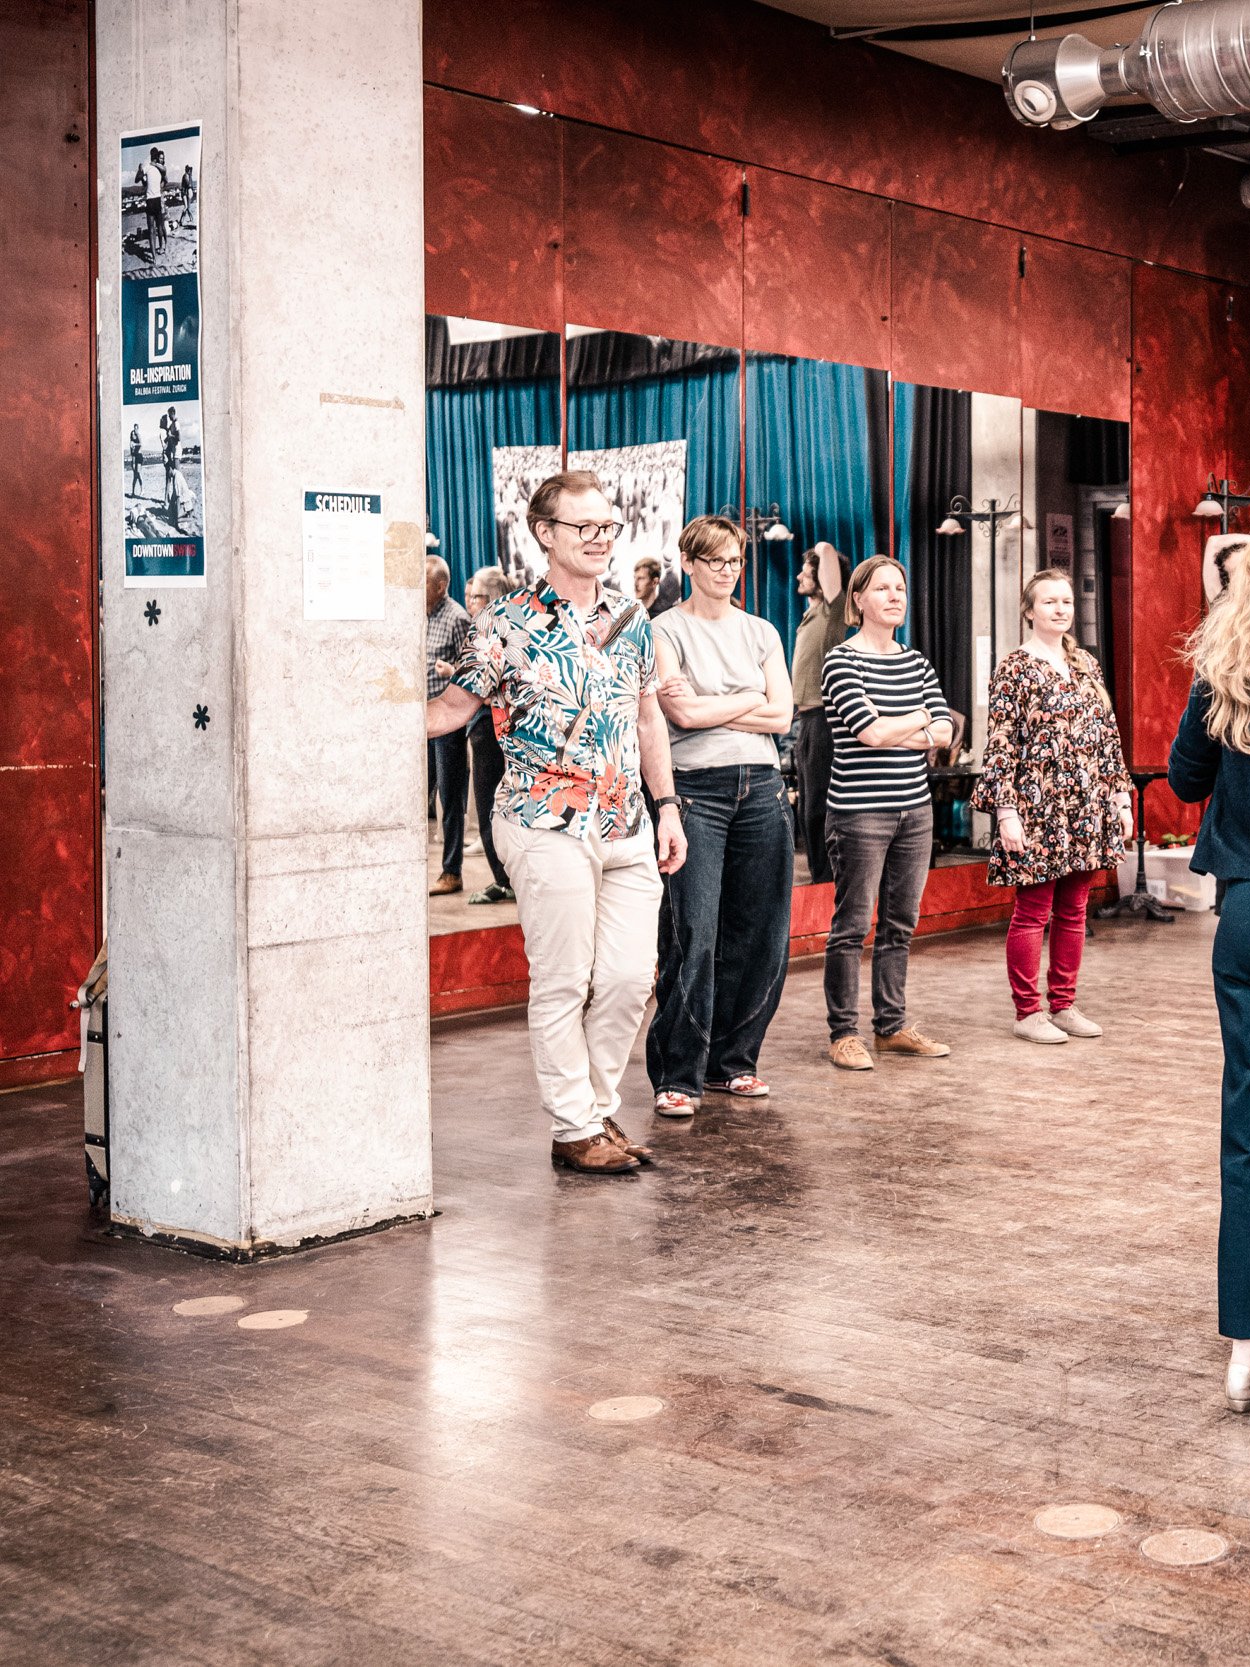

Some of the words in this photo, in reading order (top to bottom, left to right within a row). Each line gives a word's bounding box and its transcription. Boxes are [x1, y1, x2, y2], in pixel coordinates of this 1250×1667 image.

[154, 308, 169, 357] B
[130, 364, 192, 385] BAL-INSPIRATION
[134, 387, 151, 396] BALBOA
[152, 385, 171, 395] FESTIVAL
[315, 494, 371, 513] SCHEDULE
[132, 543, 197, 558] DOWNTOWNSWING
